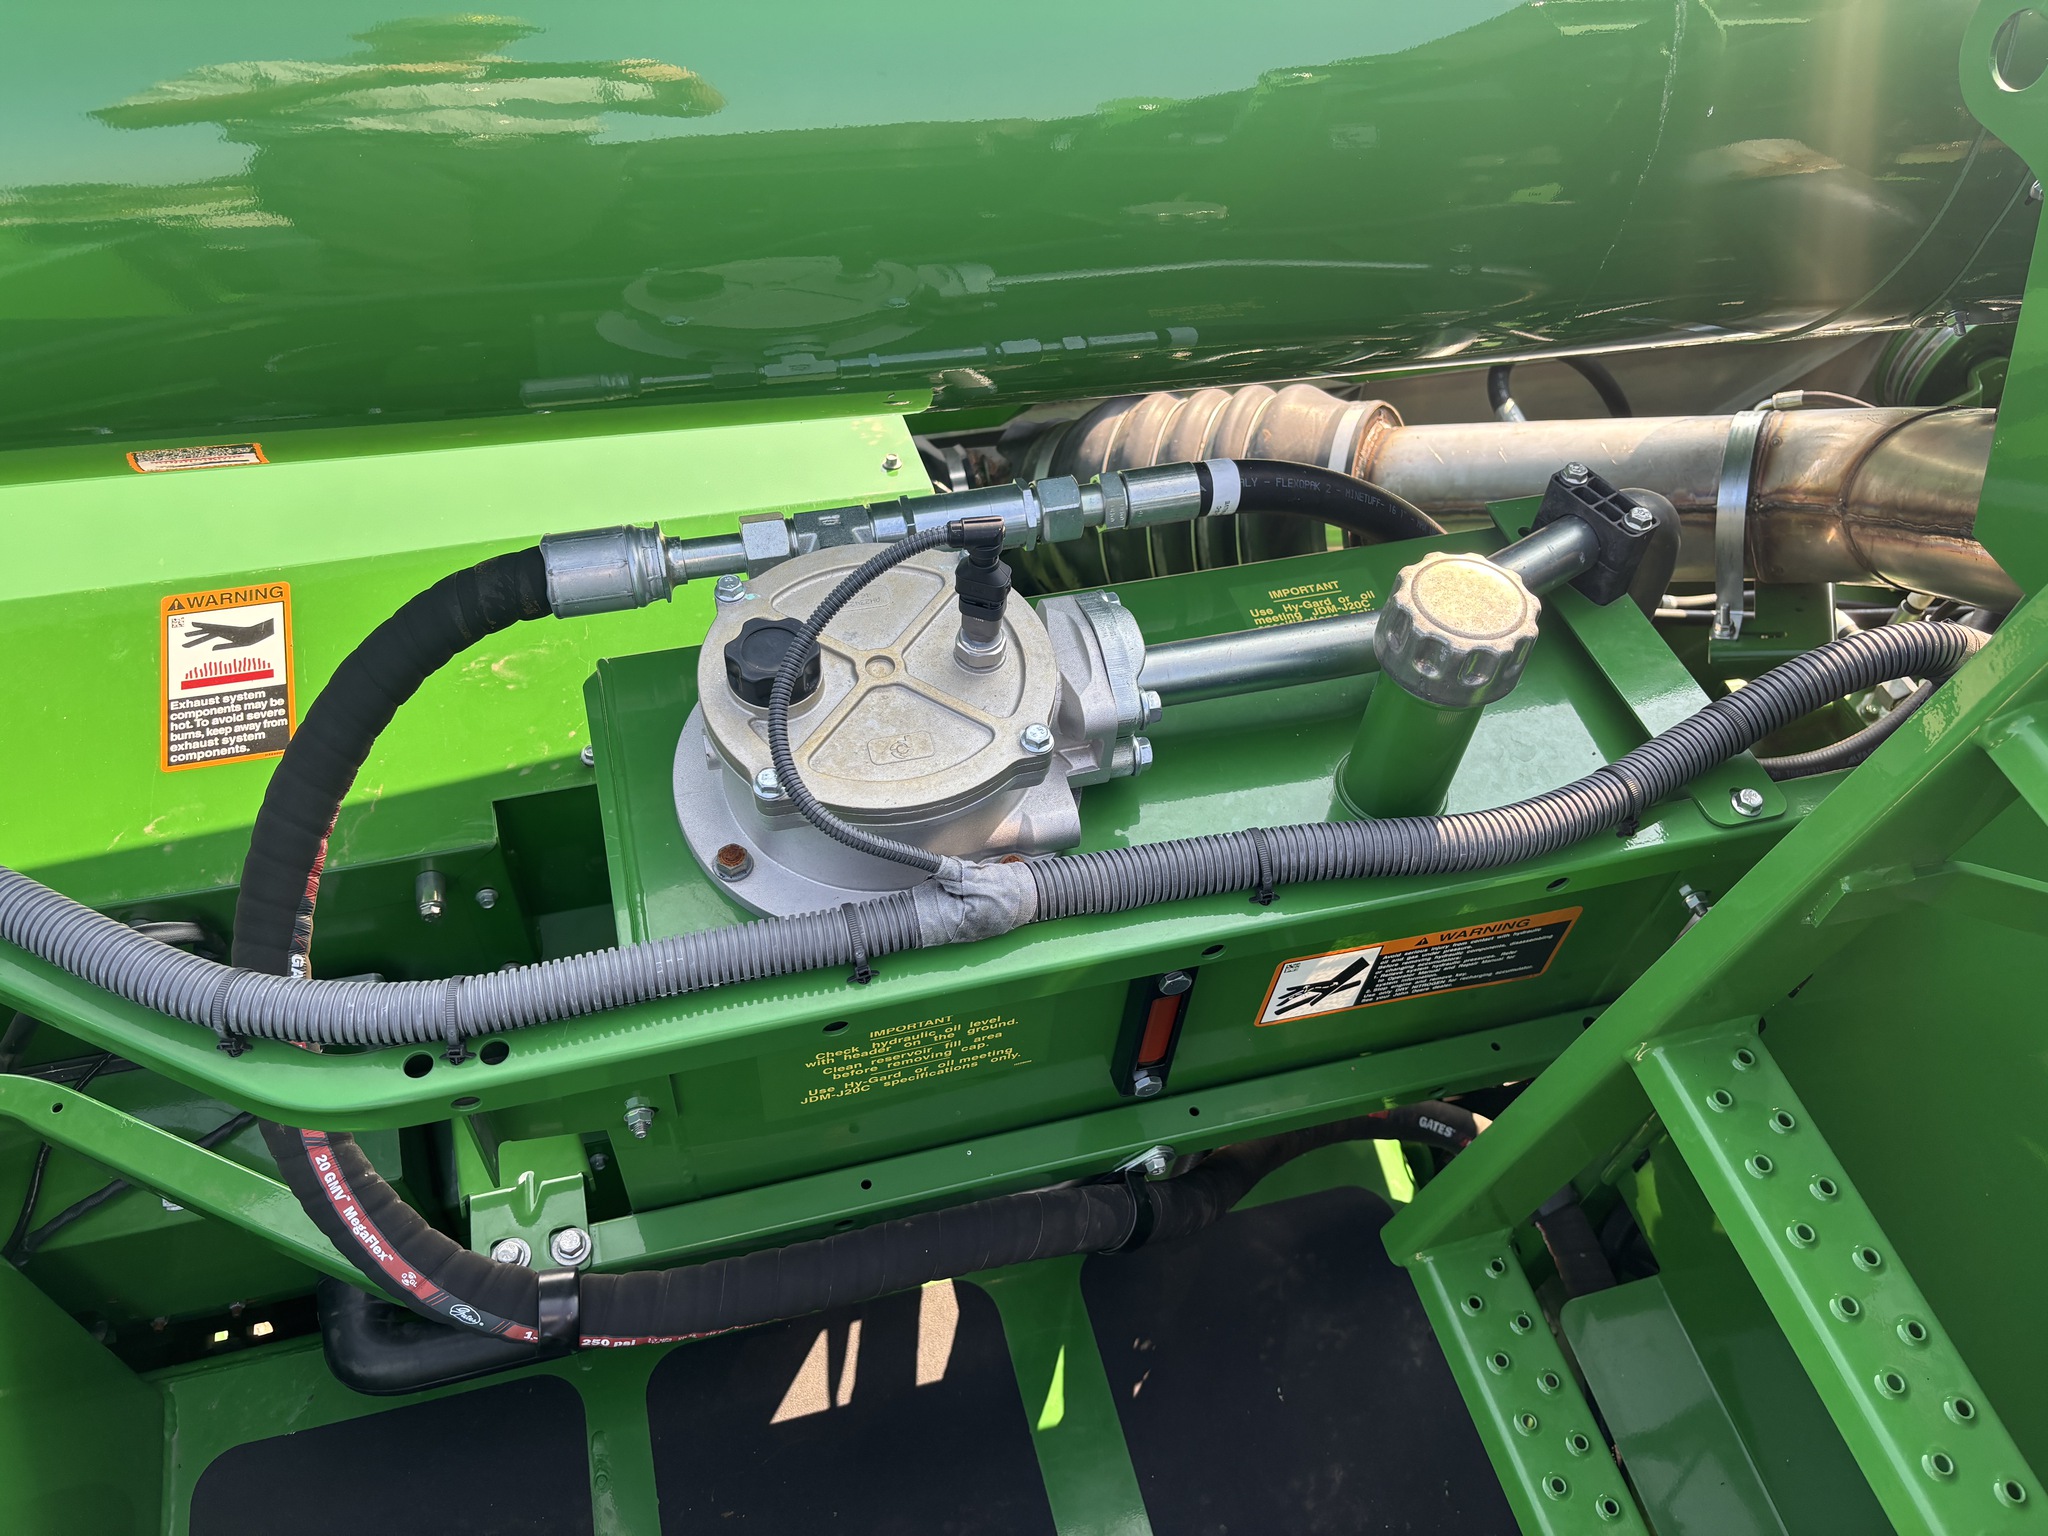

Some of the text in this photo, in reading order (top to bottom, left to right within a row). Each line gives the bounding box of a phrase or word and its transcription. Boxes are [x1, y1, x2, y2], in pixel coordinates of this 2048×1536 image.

[1240, 477, 1258, 488] ALY
[1276, 478, 1321, 492] FLEXOPAK
[1325, 484, 1332, 494] 2
[186, 586, 284, 609] WARNING
[1268, 580, 1340, 600] IMPORTANT
[1250, 590, 1376, 618] Use Hy-Gard or oil
[1254, 610, 1303, 626] meeting
[1312, 598, 1371, 615] JDM-J20C
[170, 690, 266, 711] Exhaust system
[170, 696, 285, 722] components may be
[170, 708, 286, 732] hot. To avoid severe
[170, 717, 288, 742] burns, keep away from
[170, 731, 266, 752] exhaust system
[170, 745, 250, 764] components.
[1439, 918, 1532, 942] WARNING
[814, 1016, 1002, 1062] Check hydraulic oil level
[869, 1015, 954, 1039] IMPORTANT
[804, 1018, 1020, 1068] with header on the ground.
[822, 1032, 1004, 1076] Clean reservoir fill area
[808, 1086, 836, 1098] Use
[844, 1071, 902, 1090] Hy-Gard
[914, 1065, 930, 1075] or
[937, 1058, 956, 1069] oil
[959, 1046, 1014, 1066] meeting
[832, 1042, 990, 1080] before removing cap.
[800, 1050, 1022, 1106] JDM-J20C specifications only.
[1418, 1116, 1453, 1138] GATES
[314, 1154, 331, 1172] 20
[581, 1338, 610, 1347] 250
[613, 1340, 637, 1348] psi
